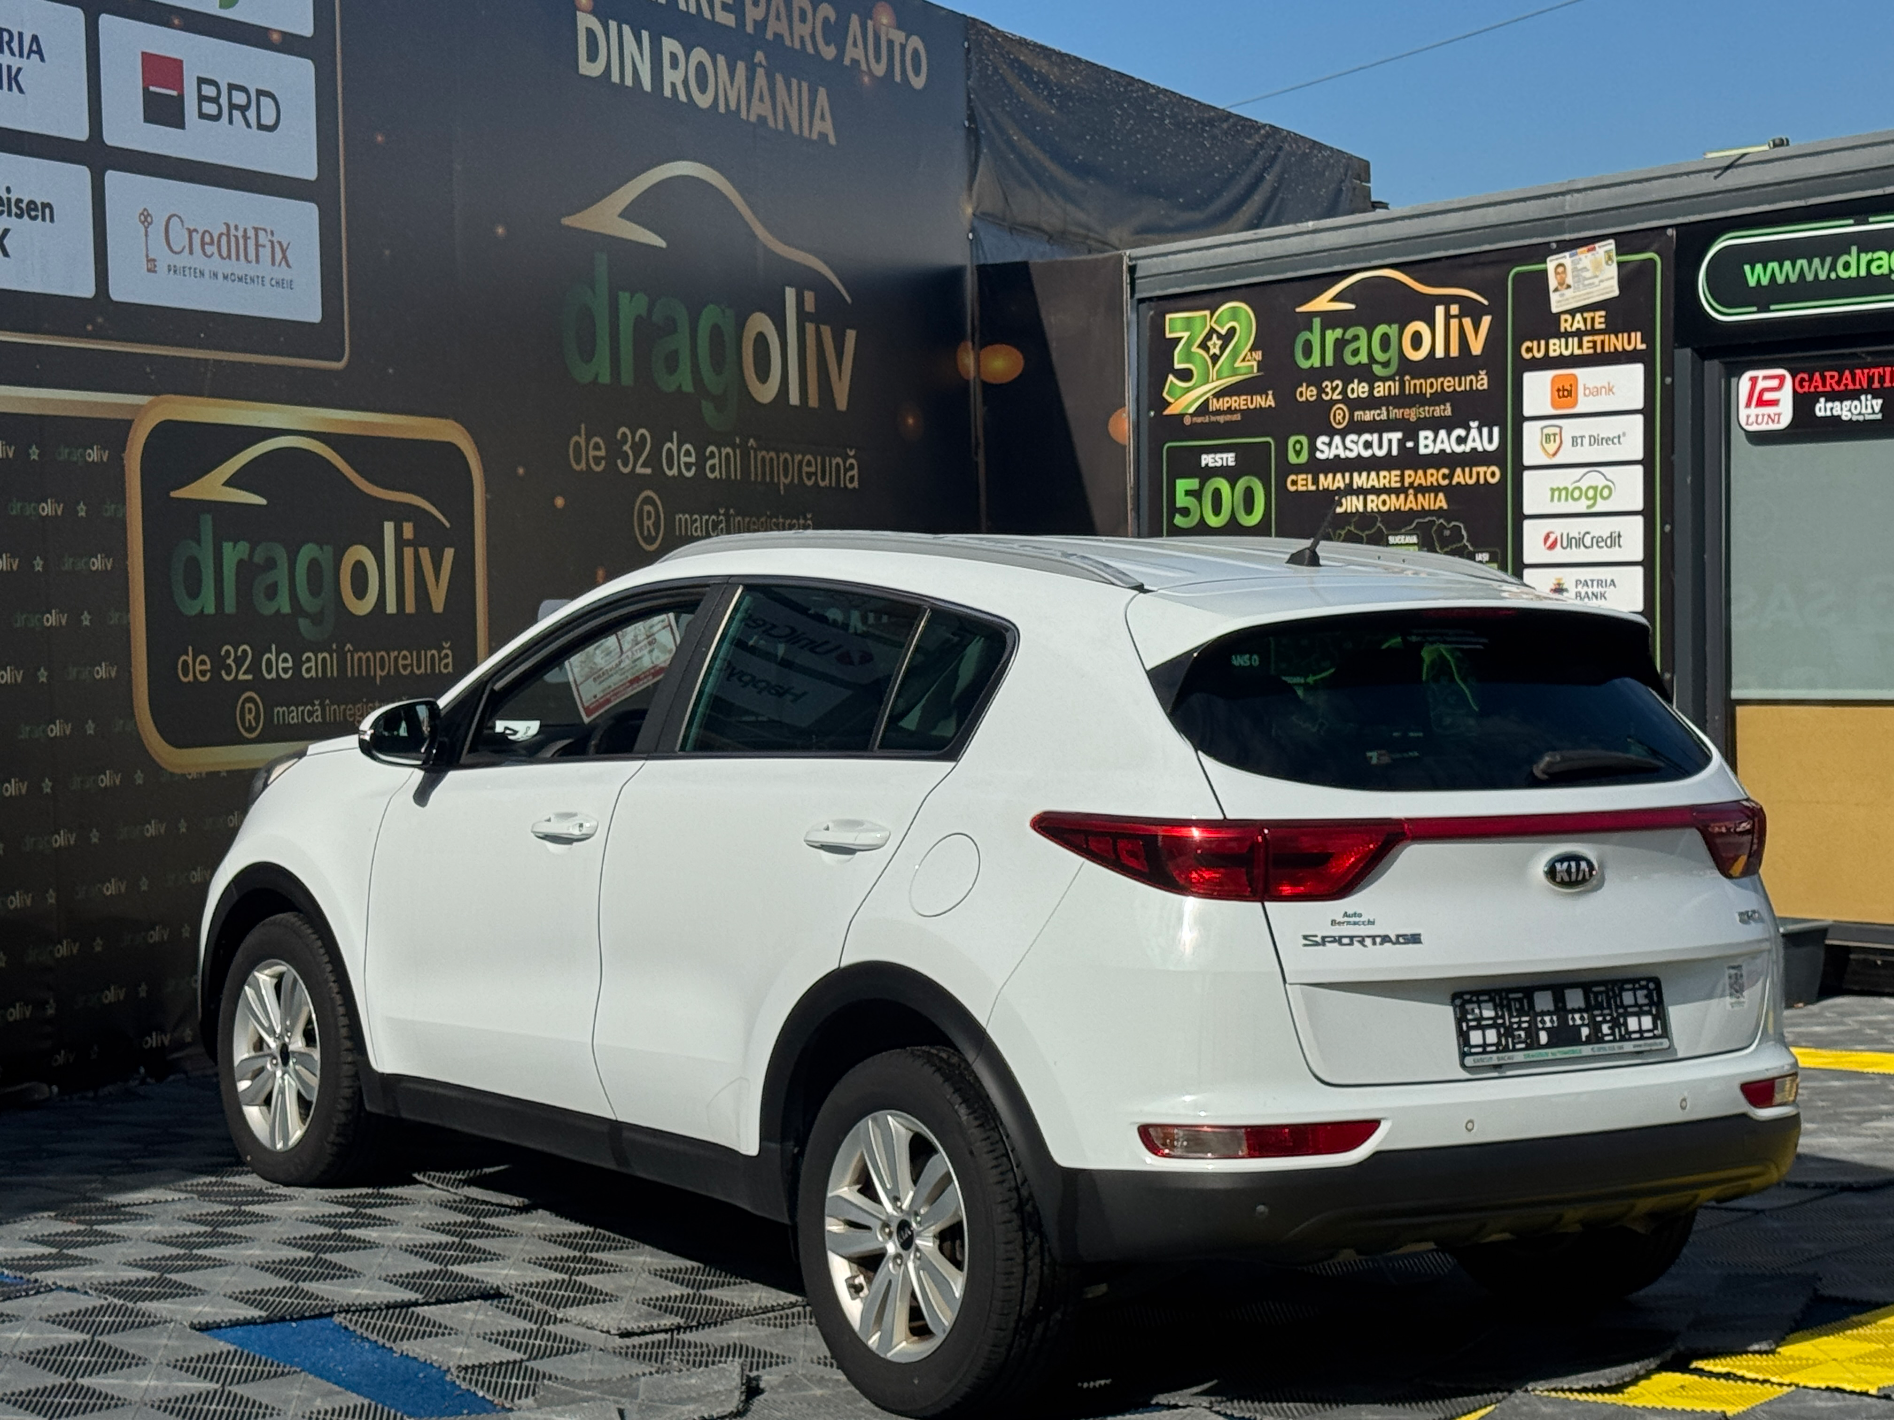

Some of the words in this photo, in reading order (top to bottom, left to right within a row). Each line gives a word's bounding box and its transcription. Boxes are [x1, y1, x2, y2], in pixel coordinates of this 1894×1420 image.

[843, 13, 927, 89] AUTO
[576, 10, 651, 93] DIN
[661, 36, 837, 146] ROMÂNIA
[196, 76, 281, 133] BRD
[164, 213, 292, 269] CreditFix
[167, 264, 206, 280] PRIETEN
[208, 270, 220, 281] IN
[222, 272, 266, 288] MOMENTE
[269, 276, 295, 290] CHEIE
[1744, 245, 1894, 287] www.dra
[1560, 311, 1606, 333] RATE
[562, 250, 857, 431] dragoliv
[1294, 304, 1492, 376] dragoliv
[1521, 341, 1545, 359] CU
[1548, 332, 1647, 357] BULETINUL
[1297, 383, 1317, 402] de
[1322, 380, 1343, 401] 32
[1347, 379, 1369, 399] de
[1374, 376, 1400, 397] ani
[1404, 370, 1488, 397] împreună
[1556, 384, 1573, 399] tbi
[1583, 381, 1615, 397] bank
[1744, 373, 1786, 409] 12
[1354, 406, 1388, 423] marcă
[1389, 403, 1452, 423] înregistrată
[1745, 411, 1782, 427] LUNI
[1815, 393, 1883, 421] dragoliv
[1315, 432, 1402, 460] SASCUT
[1418, 421, 1500, 457] BACĂU
[1544, 432, 1558, 445] BT
[1571, 435, 1586, 447] BT
[569, 423, 606, 472] de
[617, 426, 652, 475] 32
[662, 431, 696, 478] de
[705, 437, 741, 480] ani
[748, 439, 859, 494] împreună
[1201, 453, 1236, 467] PESTE
[1287, 473, 1316, 492] CEL
[1353, 469, 1401, 489] MARE
[1404, 467, 1449, 488] PARC
[1452, 466, 1500, 486] AUTO
[1173, 475, 1266, 529] 500
[1367, 492, 1448, 513] ROMÂNIA
[1549, 484, 1613, 510] mogo
[675, 507, 726, 537] marcă
[1560, 531, 1622, 550] UniCredit
[170, 513, 456, 643] dragoliv
[1575, 579, 1617, 589] PATRIA
[178, 646, 211, 683] de
[220, 644, 253, 681] 32
[262, 643, 293, 680] de
[301, 642, 338, 679] ani
[344, 641, 454, 685] împreună
[274, 699, 323, 726] marcă
[1554, 860, 1590, 882] KIA
[1342, 911, 1363, 919] Auto
[1301, 932, 1423, 949] SPORTAGE
